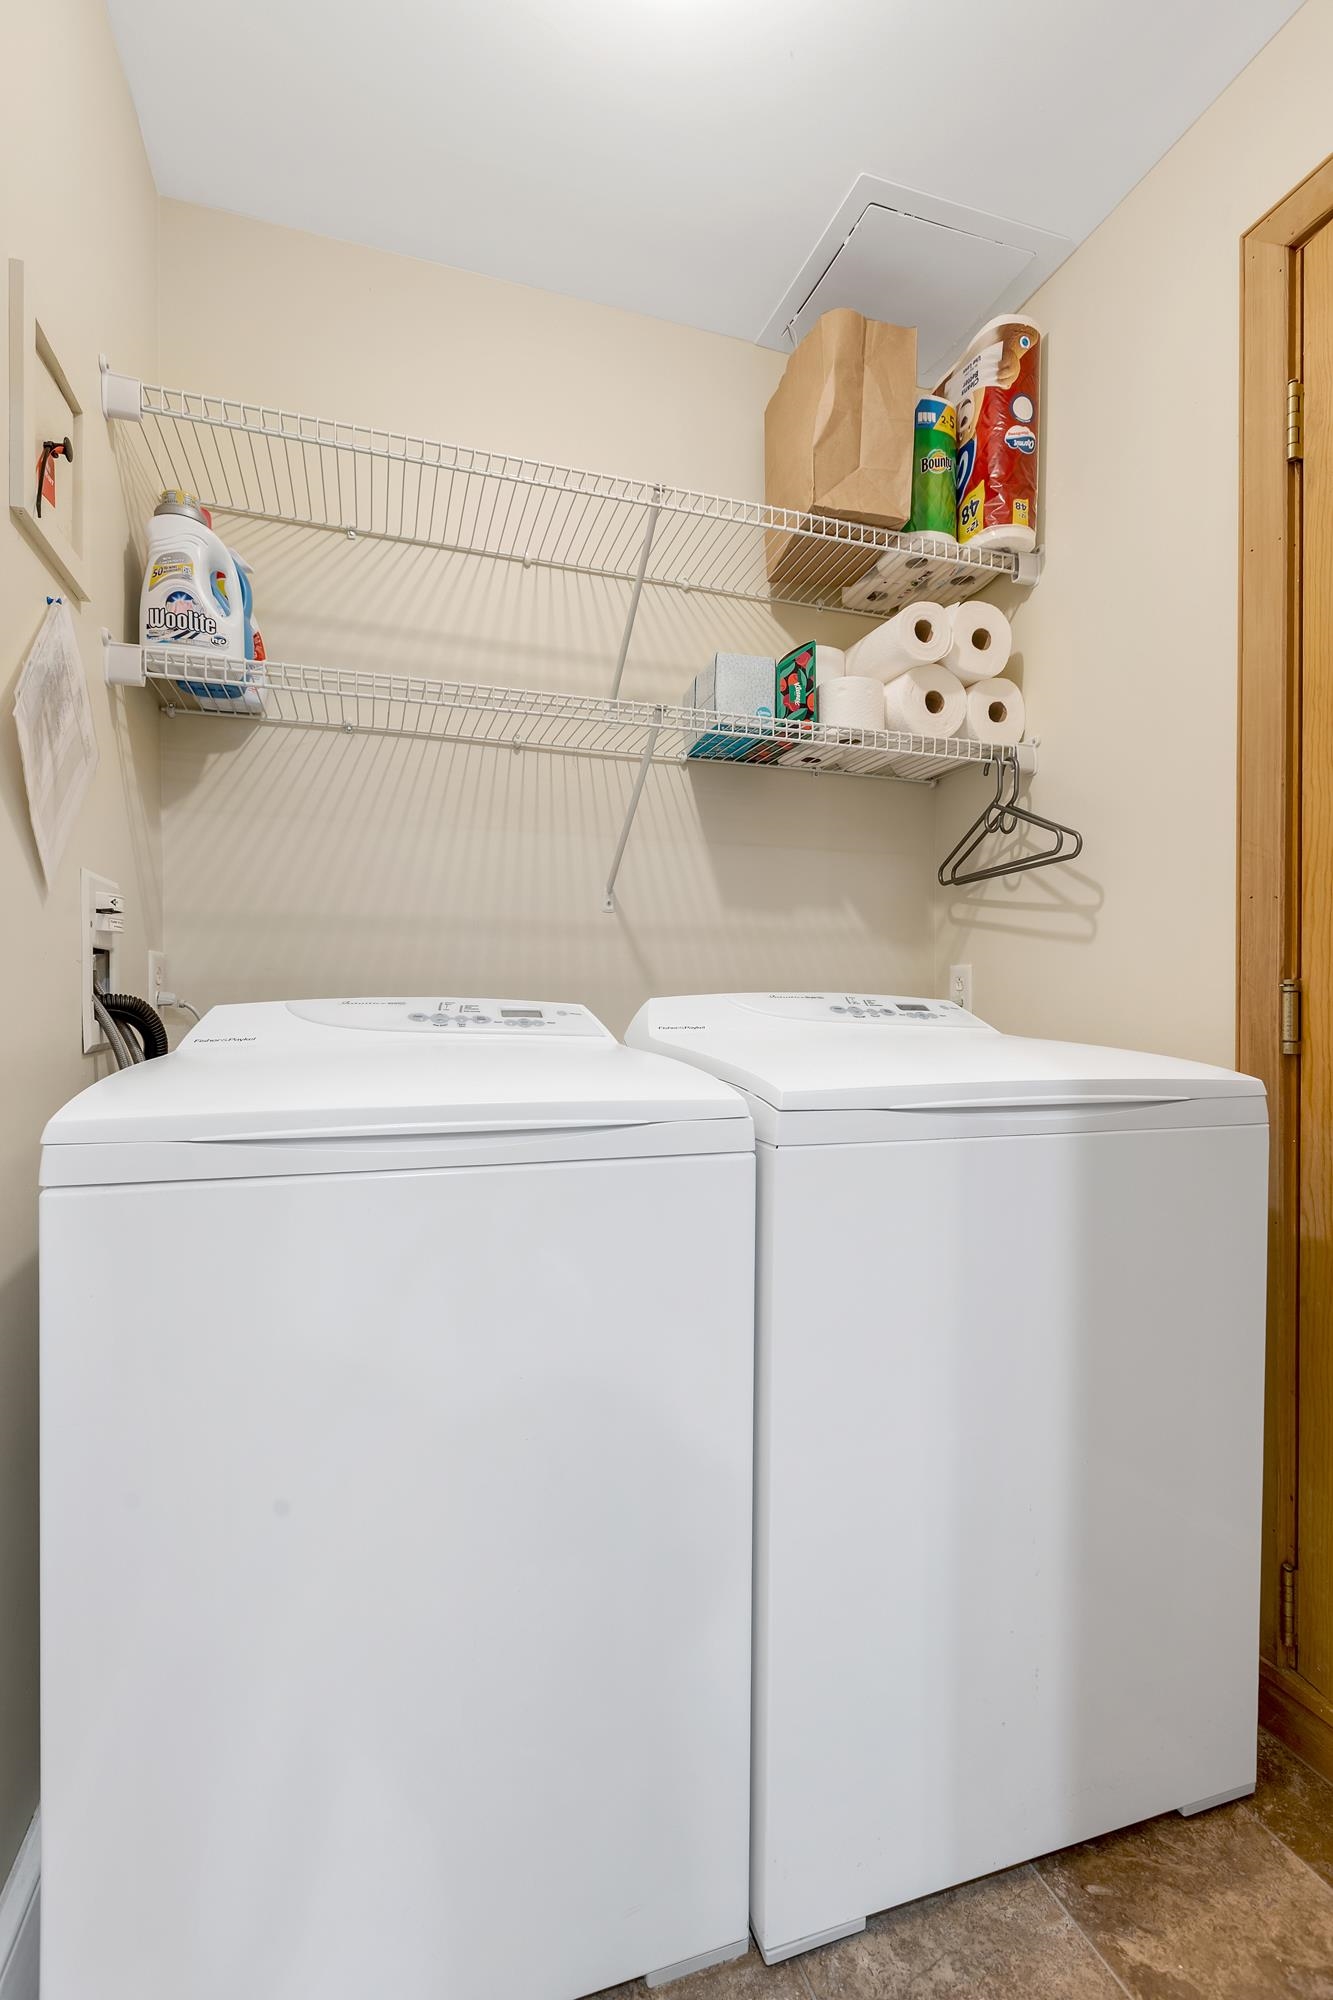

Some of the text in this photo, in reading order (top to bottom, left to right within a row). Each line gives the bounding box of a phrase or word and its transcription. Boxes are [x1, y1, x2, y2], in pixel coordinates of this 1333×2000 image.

[921, 456, 952, 473] Bounty
[961, 499, 980, 525] 48
[1015, 502, 1027, 511] 48
[151, 566, 163, 578] 50
[148, 608, 217, 635] Woolite
